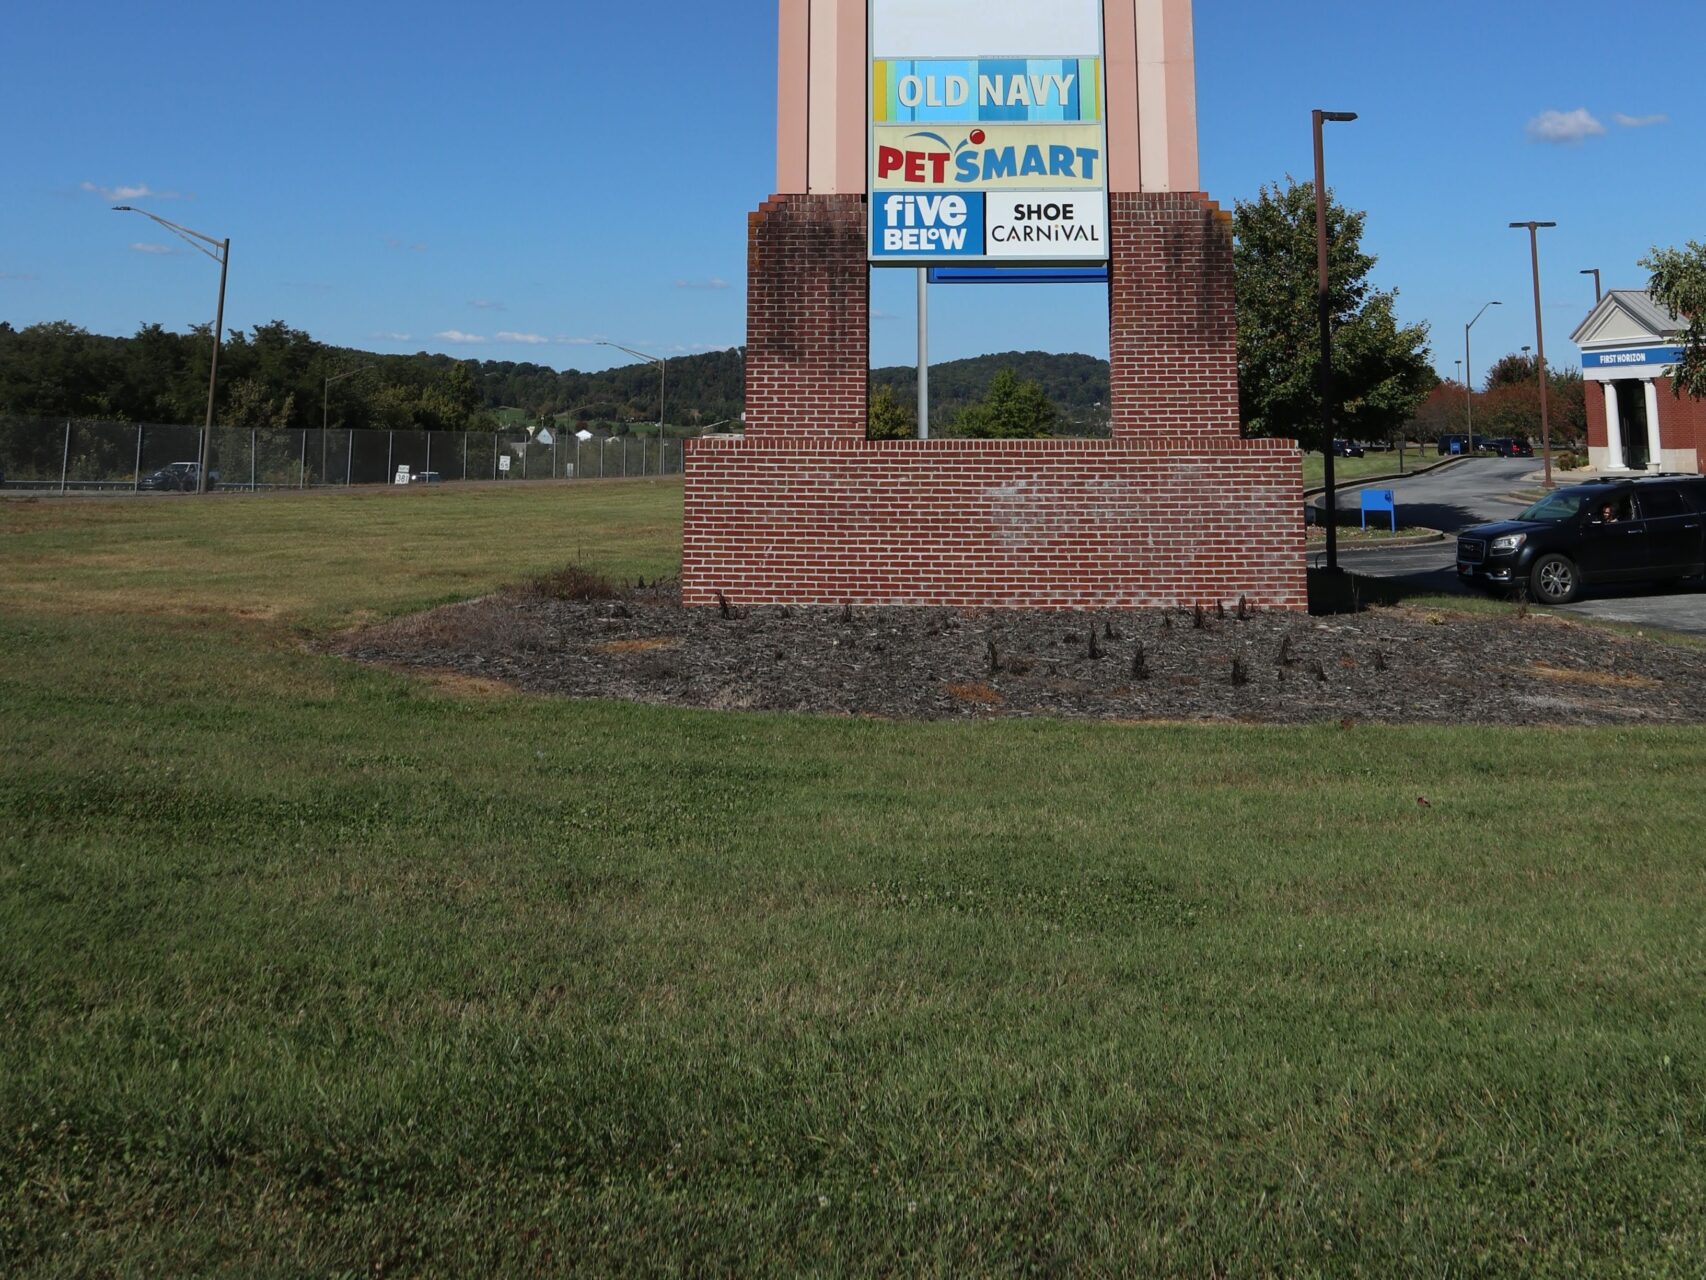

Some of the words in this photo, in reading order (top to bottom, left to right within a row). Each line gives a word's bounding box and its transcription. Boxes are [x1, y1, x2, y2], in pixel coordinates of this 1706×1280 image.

[898, 74, 969, 107] OLD
[978, 73, 1075, 107] NAVY
[884, 194, 967, 227] five
[1014, 203, 1074, 221] SHOE
[884, 228, 967, 251] BELOW
[1600, 354, 1617, 364] FIRST
[1617, 353, 1646, 363] HORIZON
